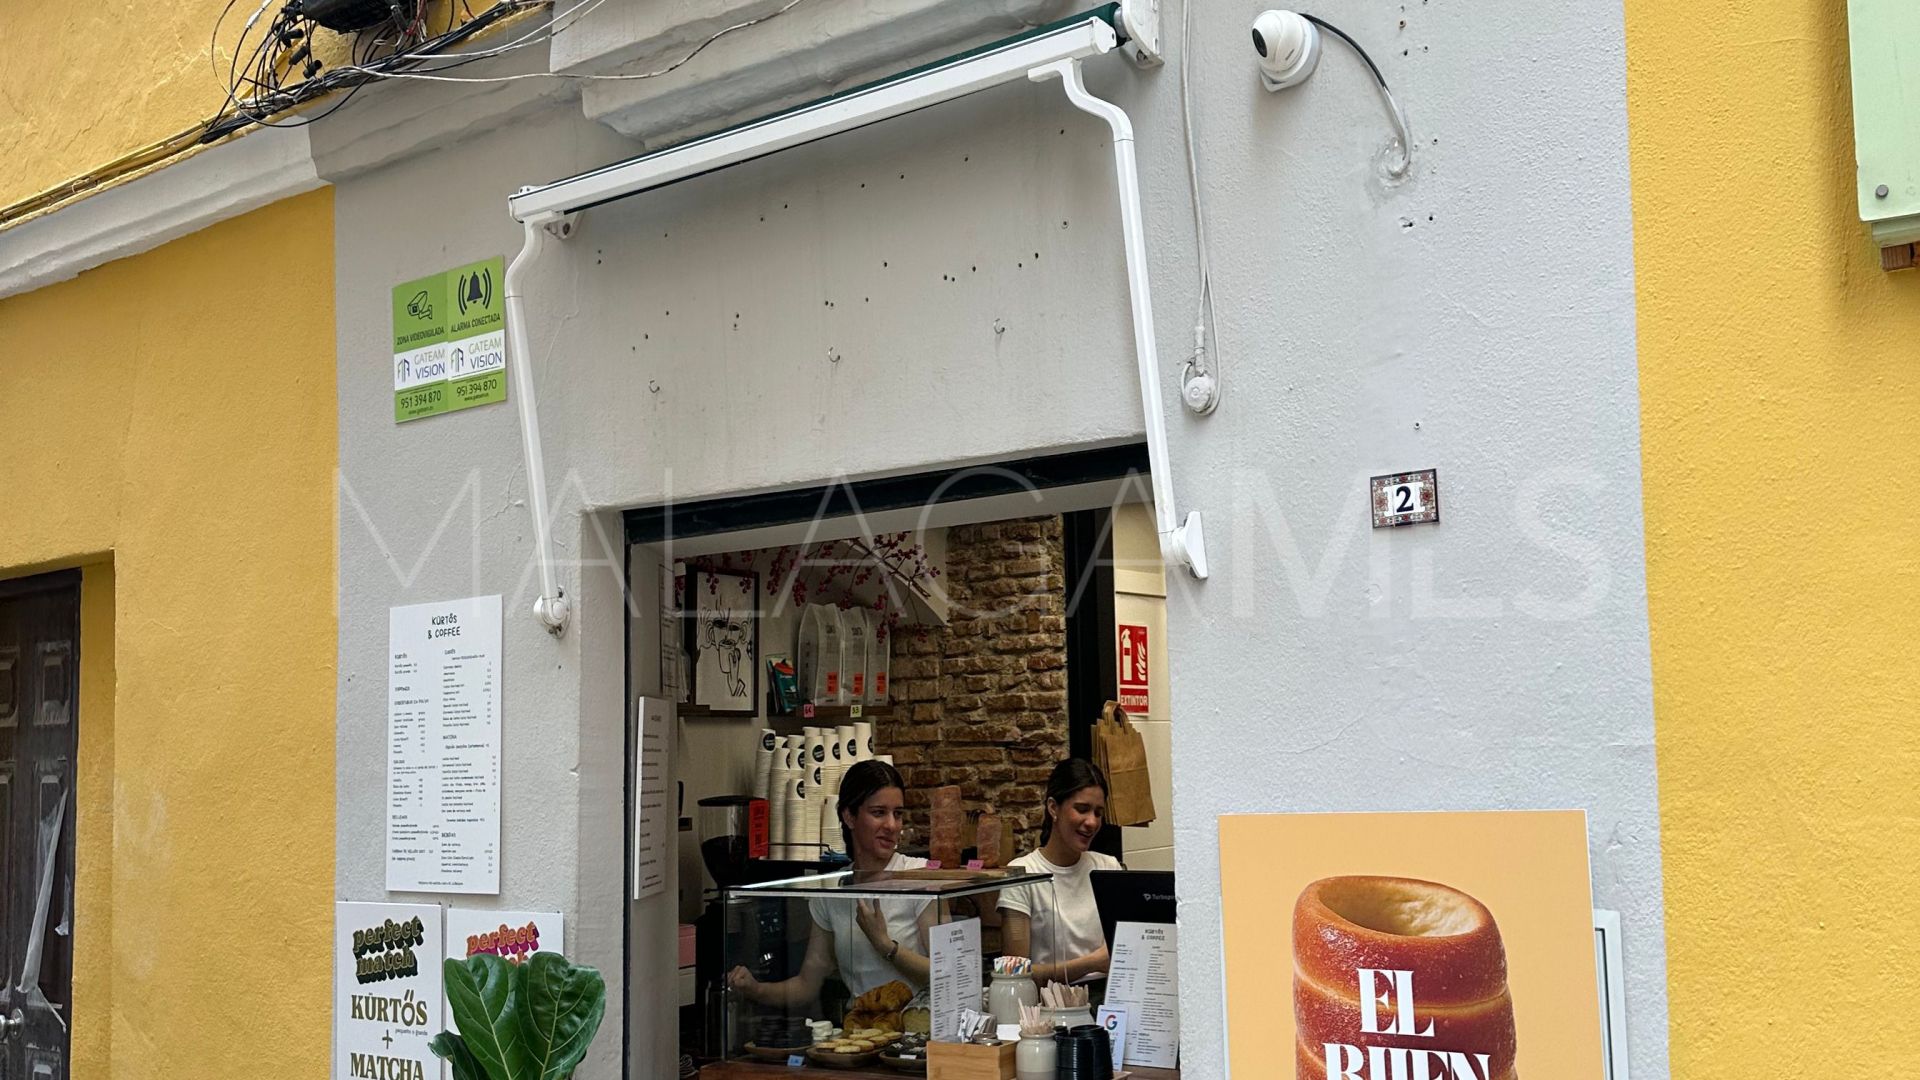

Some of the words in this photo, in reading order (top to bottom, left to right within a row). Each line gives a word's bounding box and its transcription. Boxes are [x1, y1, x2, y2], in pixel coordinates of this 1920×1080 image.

[451, 321, 471, 333] ALARMA
[472, 313, 500, 327] CONECTADA
[397, 336, 409, 345] ZONA
[468, 338, 502, 355] GATEAM
[414, 349, 446, 365] GATEAM
[470, 351, 502, 370] VISION
[415, 363, 446, 380] VISION
[456, 385, 467, 399] 951
[469, 382, 482, 395] 394
[483, 378, 497, 392] 870
[400, 395, 412, 409] 951
[414, 392, 427, 407] 394
[428, 389, 442, 404] 870
[1395, 485, 1415, 513] 2
[427, 629, 433, 640] &
[434, 625, 461, 639] COFFEE
[1120, 694, 1148, 706] EXTINTOR
[353, 915, 424, 957] perfect
[466, 920, 540, 958] perfect
[356, 945, 419, 984] match
[1356, 967, 1435, 1037] EL
[350, 1052, 424, 1080] MATCHA
